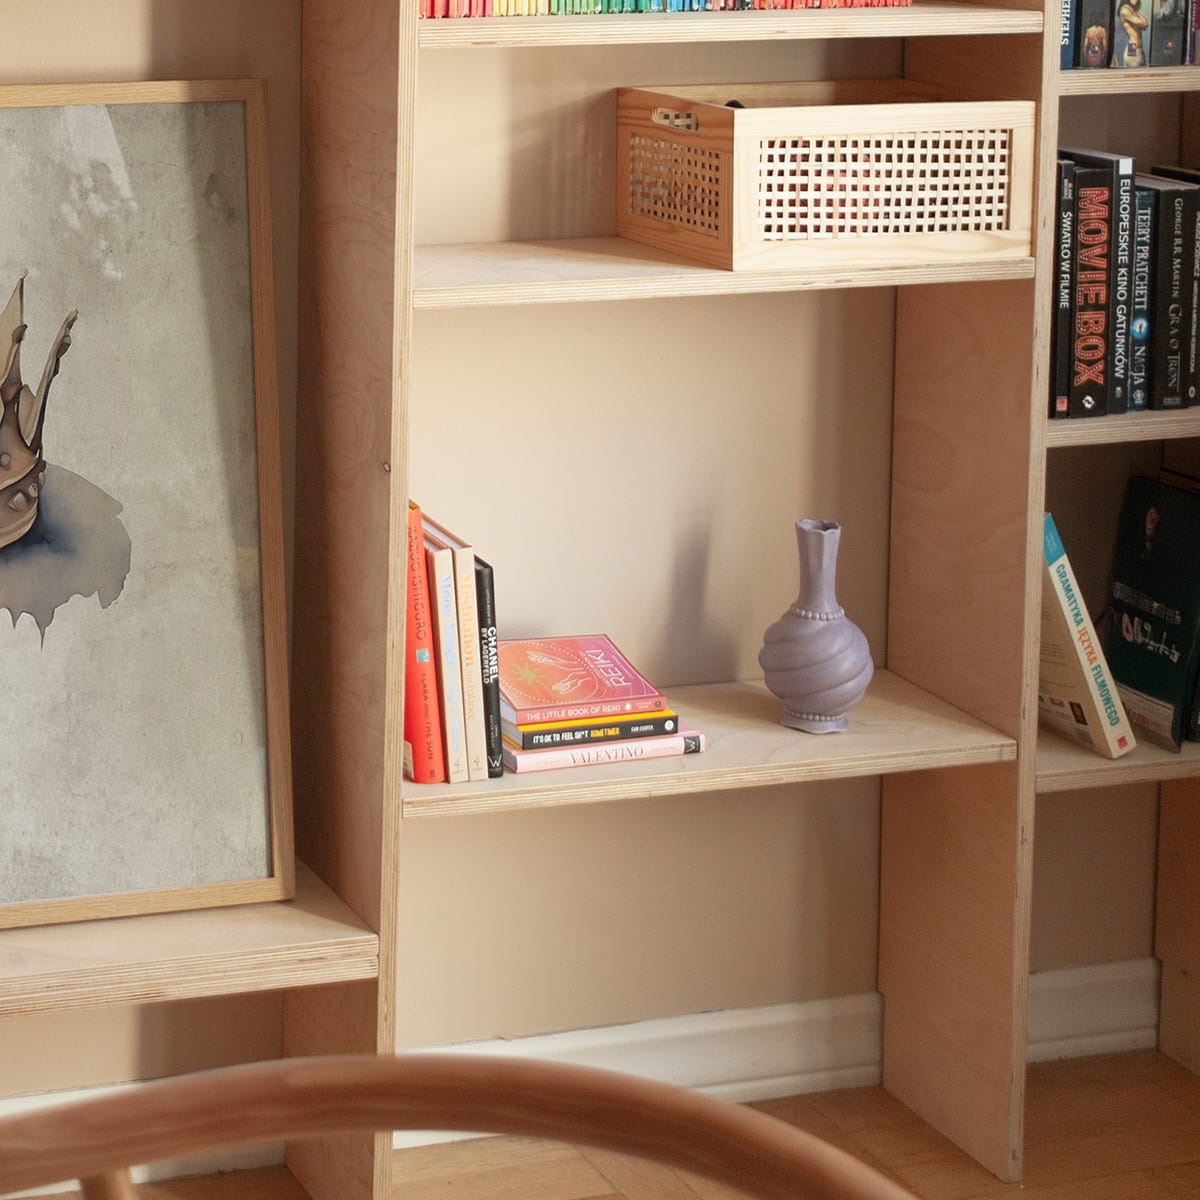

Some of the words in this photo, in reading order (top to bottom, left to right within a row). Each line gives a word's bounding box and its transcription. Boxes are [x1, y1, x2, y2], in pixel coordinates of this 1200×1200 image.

[1060, 211, 1072, 258] ŚWIATŁO
[1118, 178, 1130, 264] EUROPEJSKIE
[1136, 207, 1152, 244] TERRY
[1076, 186, 1109, 305] MOVIE
[1060, 260, 1070, 272] W
[1116, 267, 1128, 301] KINO
[1134, 245, 1150, 311] PRATCHETT
[1059, 274, 1070, 308] FILMIE
[1168, 304, 1182, 336] GRA
[1074, 311, 1106, 387] BOX
[1114, 304, 1128, 378] GATUNKÓW
[1132, 345, 1146, 385] NACJA
[412, 574, 426, 641] ISHIGURO
[481, 627, 488, 638] BY
[1056, 563, 1084, 628] GRAMATYKA
[1077, 628, 1098, 666] JĘZYKA
[1091, 664, 1121, 727] FILMOWEGO
[481, 640, 490, 684] LAGERFELD
[488, 626, 499, 684] CHANEL
[584, 649, 632, 687] REIKI
[424, 720, 432, 740] THE
[526, 712, 541, 721] THE
[542, 710, 566, 720] LITTLE
[568, 708, 589, 718] BOOK
[590, 706, 600, 715] OF
[602, 704, 622, 714] REIKI
[426, 741, 434, 760] SUN
[544, 734, 552, 743] OK
[552, 732, 560, 742] TO
[562, 732, 574, 741] FEEL
[590, 726, 620, 738] SOMETIMES
[570, 746, 644, 765] VALENTINO
